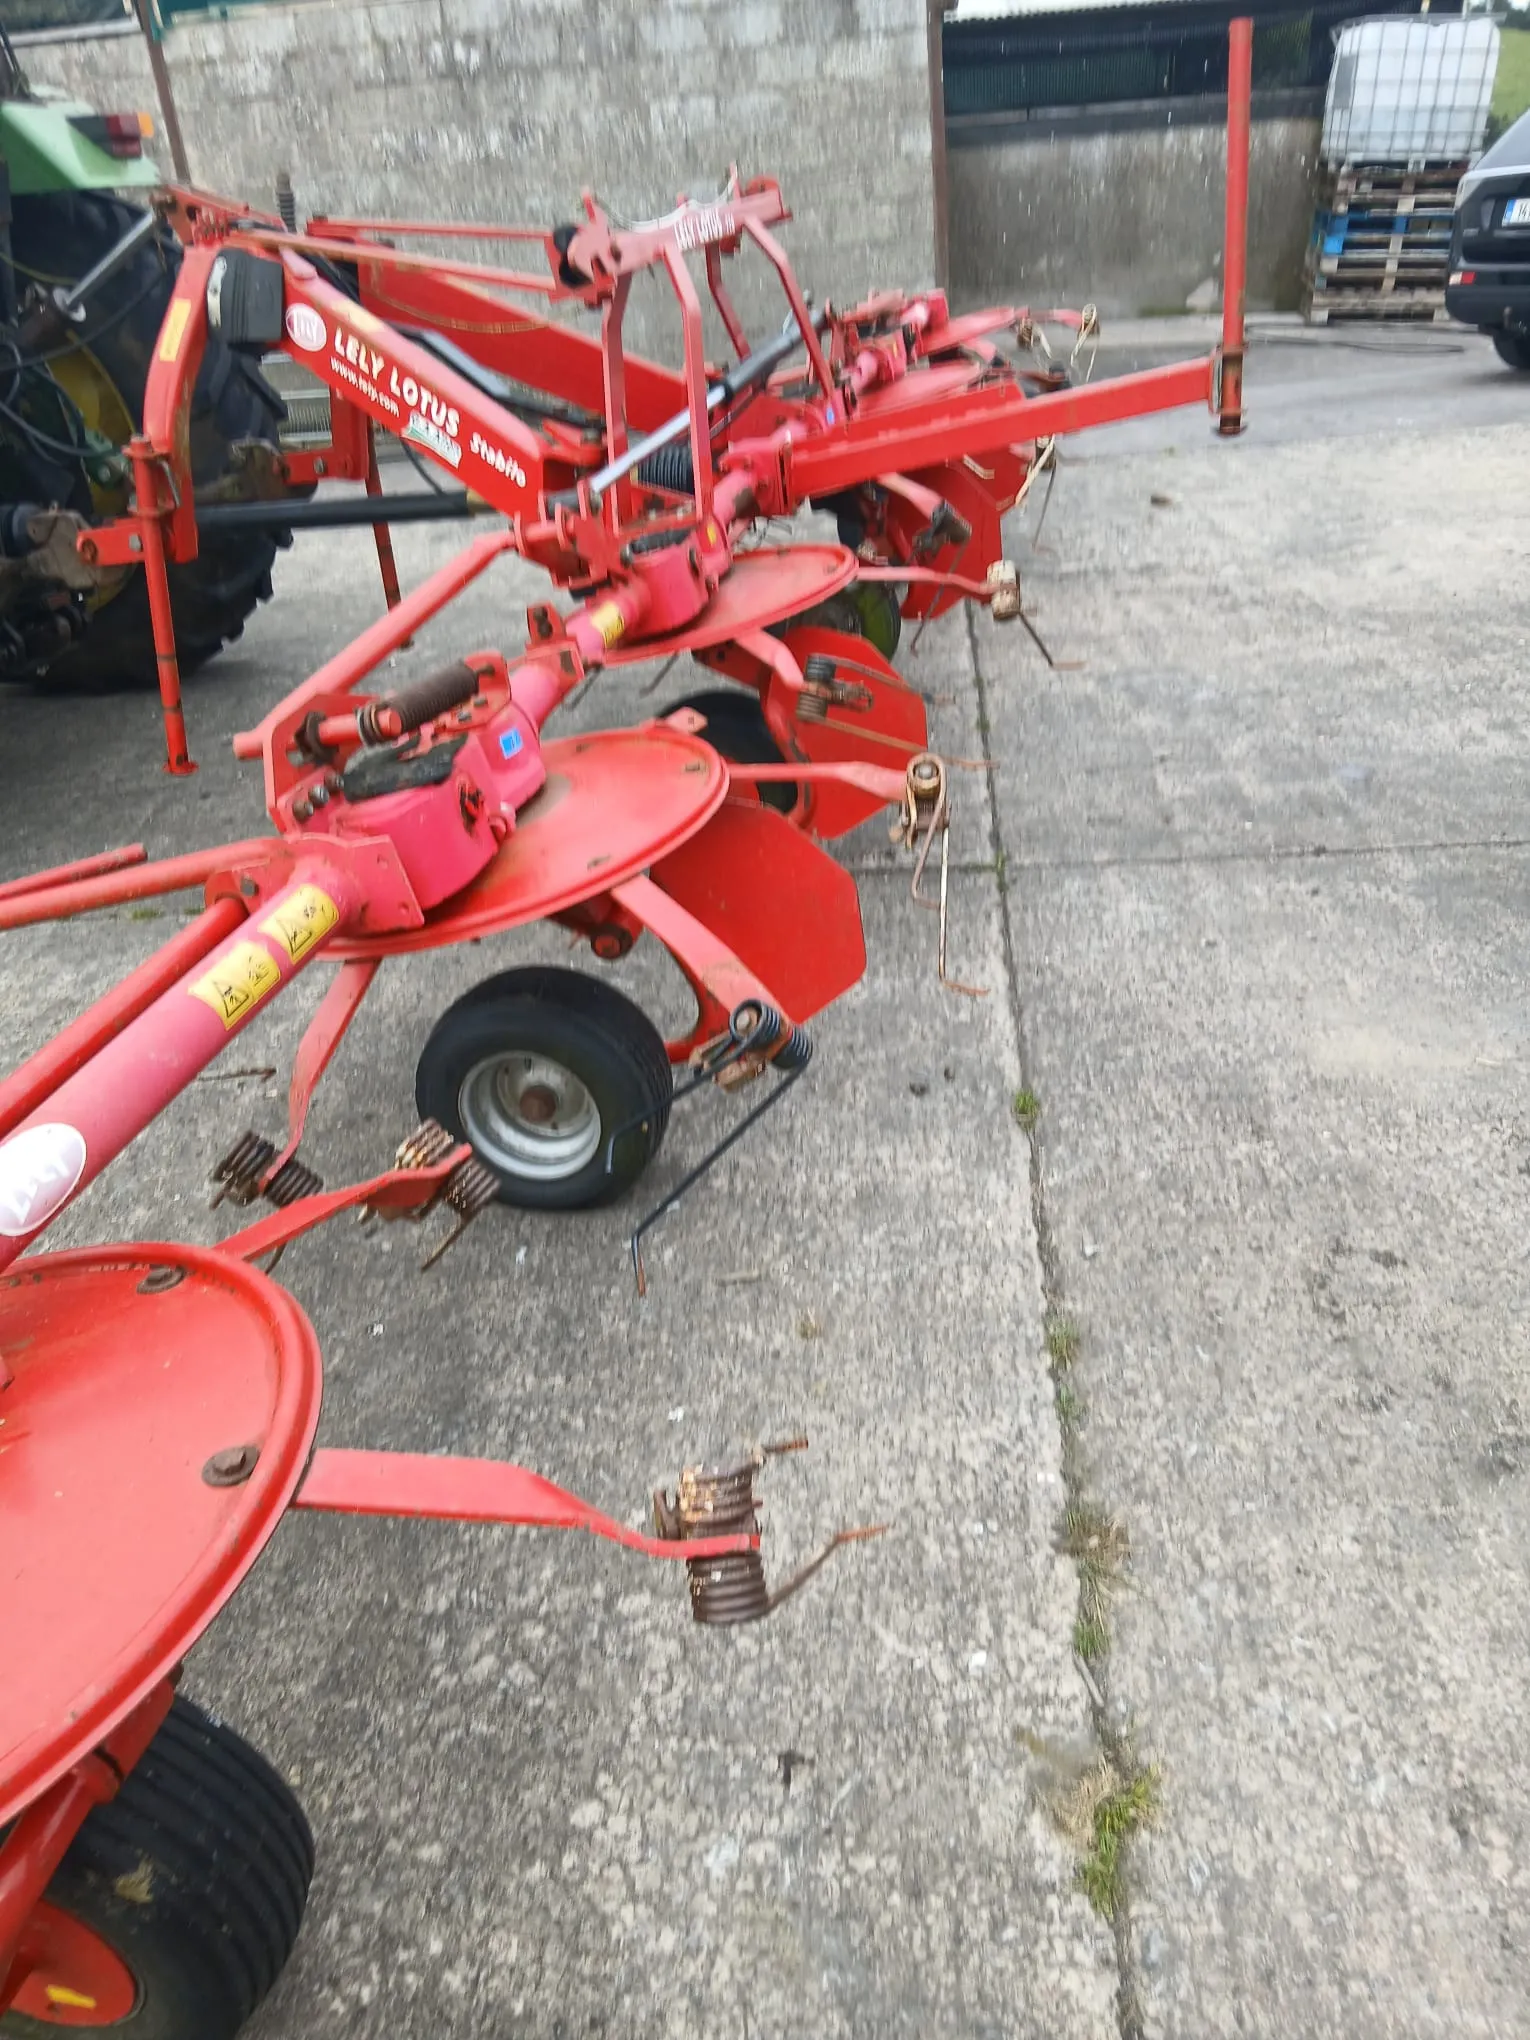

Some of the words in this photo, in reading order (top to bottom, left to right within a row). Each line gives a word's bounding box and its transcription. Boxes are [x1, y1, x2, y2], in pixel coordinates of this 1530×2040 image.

[334, 327, 385, 381] LELY
[390, 366, 460, 437] LOTUS
[469, 431, 527, 488] Stabilo
